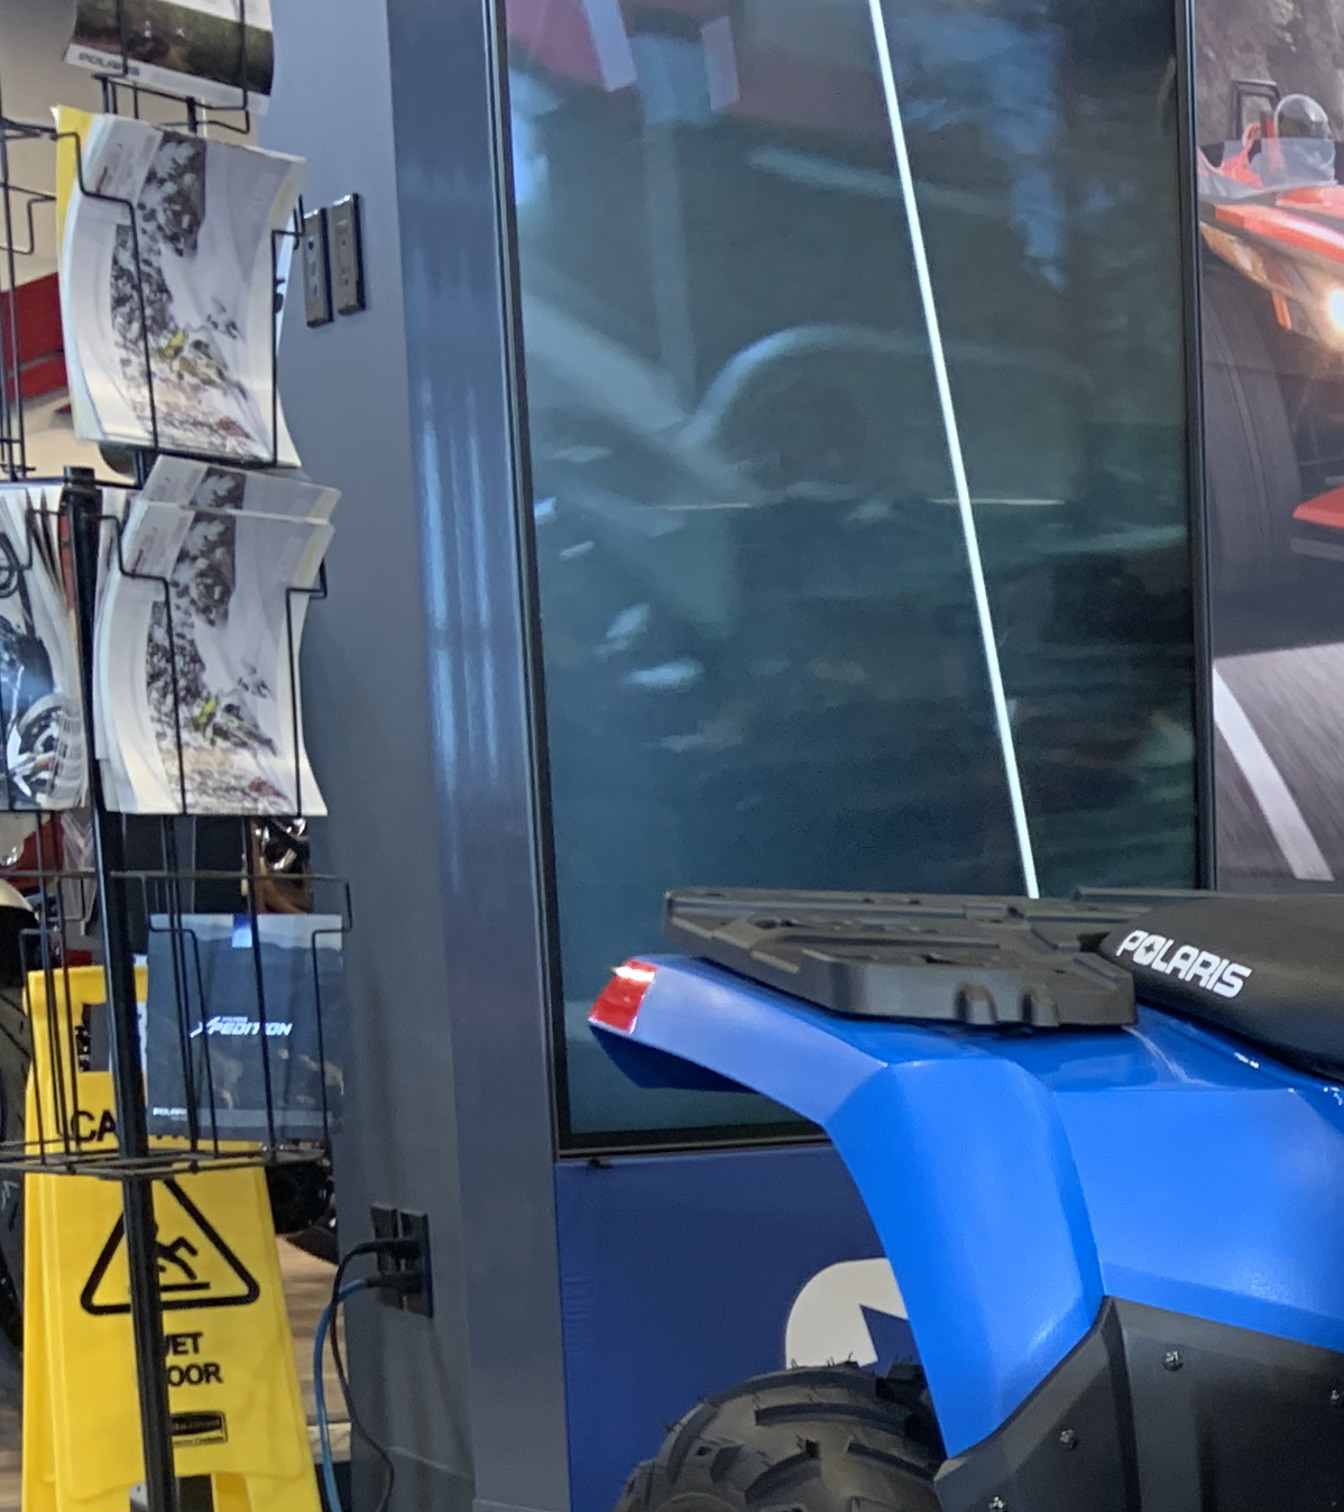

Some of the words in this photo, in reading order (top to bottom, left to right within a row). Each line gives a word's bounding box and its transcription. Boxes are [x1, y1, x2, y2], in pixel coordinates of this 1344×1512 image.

[79, 52, 140, 76] POLARS
[1115, 929, 1253, 998] POLARIS
[166, 1361, 224, 1388] OOR
